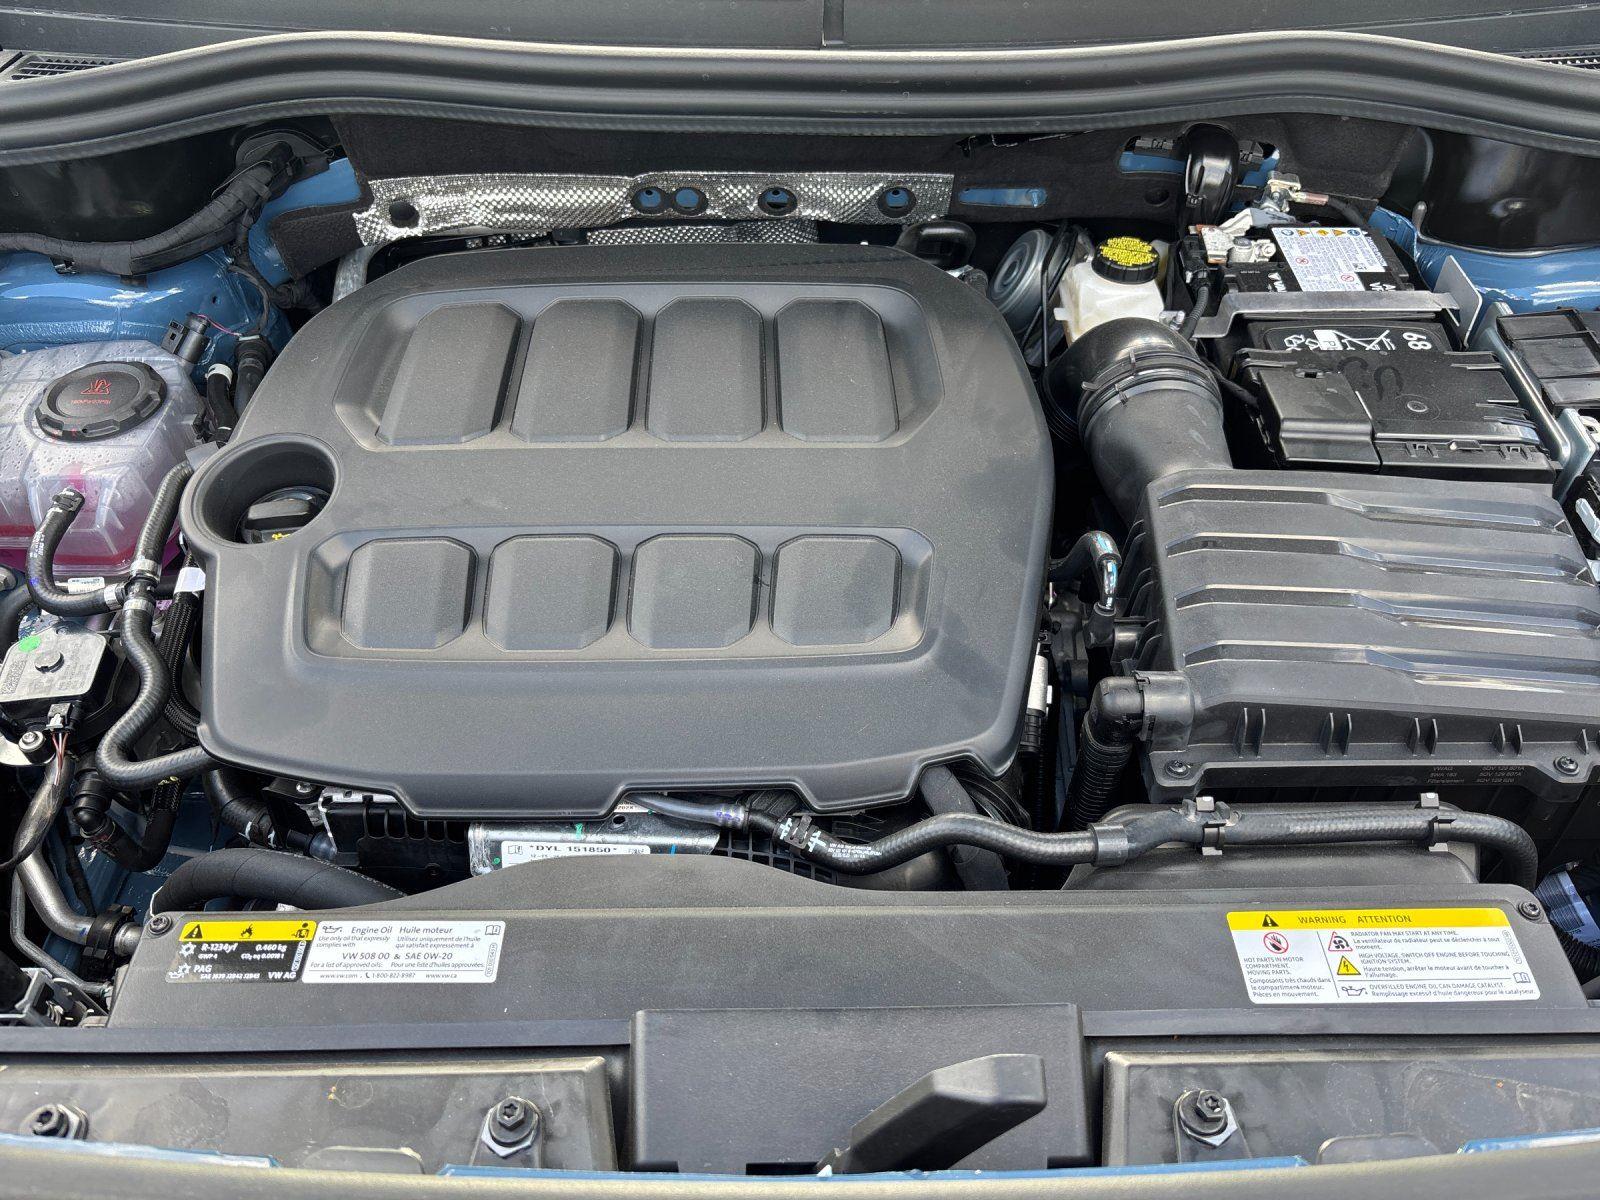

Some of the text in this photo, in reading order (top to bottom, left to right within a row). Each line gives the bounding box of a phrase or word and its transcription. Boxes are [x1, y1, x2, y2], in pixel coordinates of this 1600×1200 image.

[1298, 914, 1412, 924] WARNING ATTENTION
[351, 926, 378, 935] Engine
[201, 943, 239, 953] R-1234yf
[278, 944, 287, 952] kg
